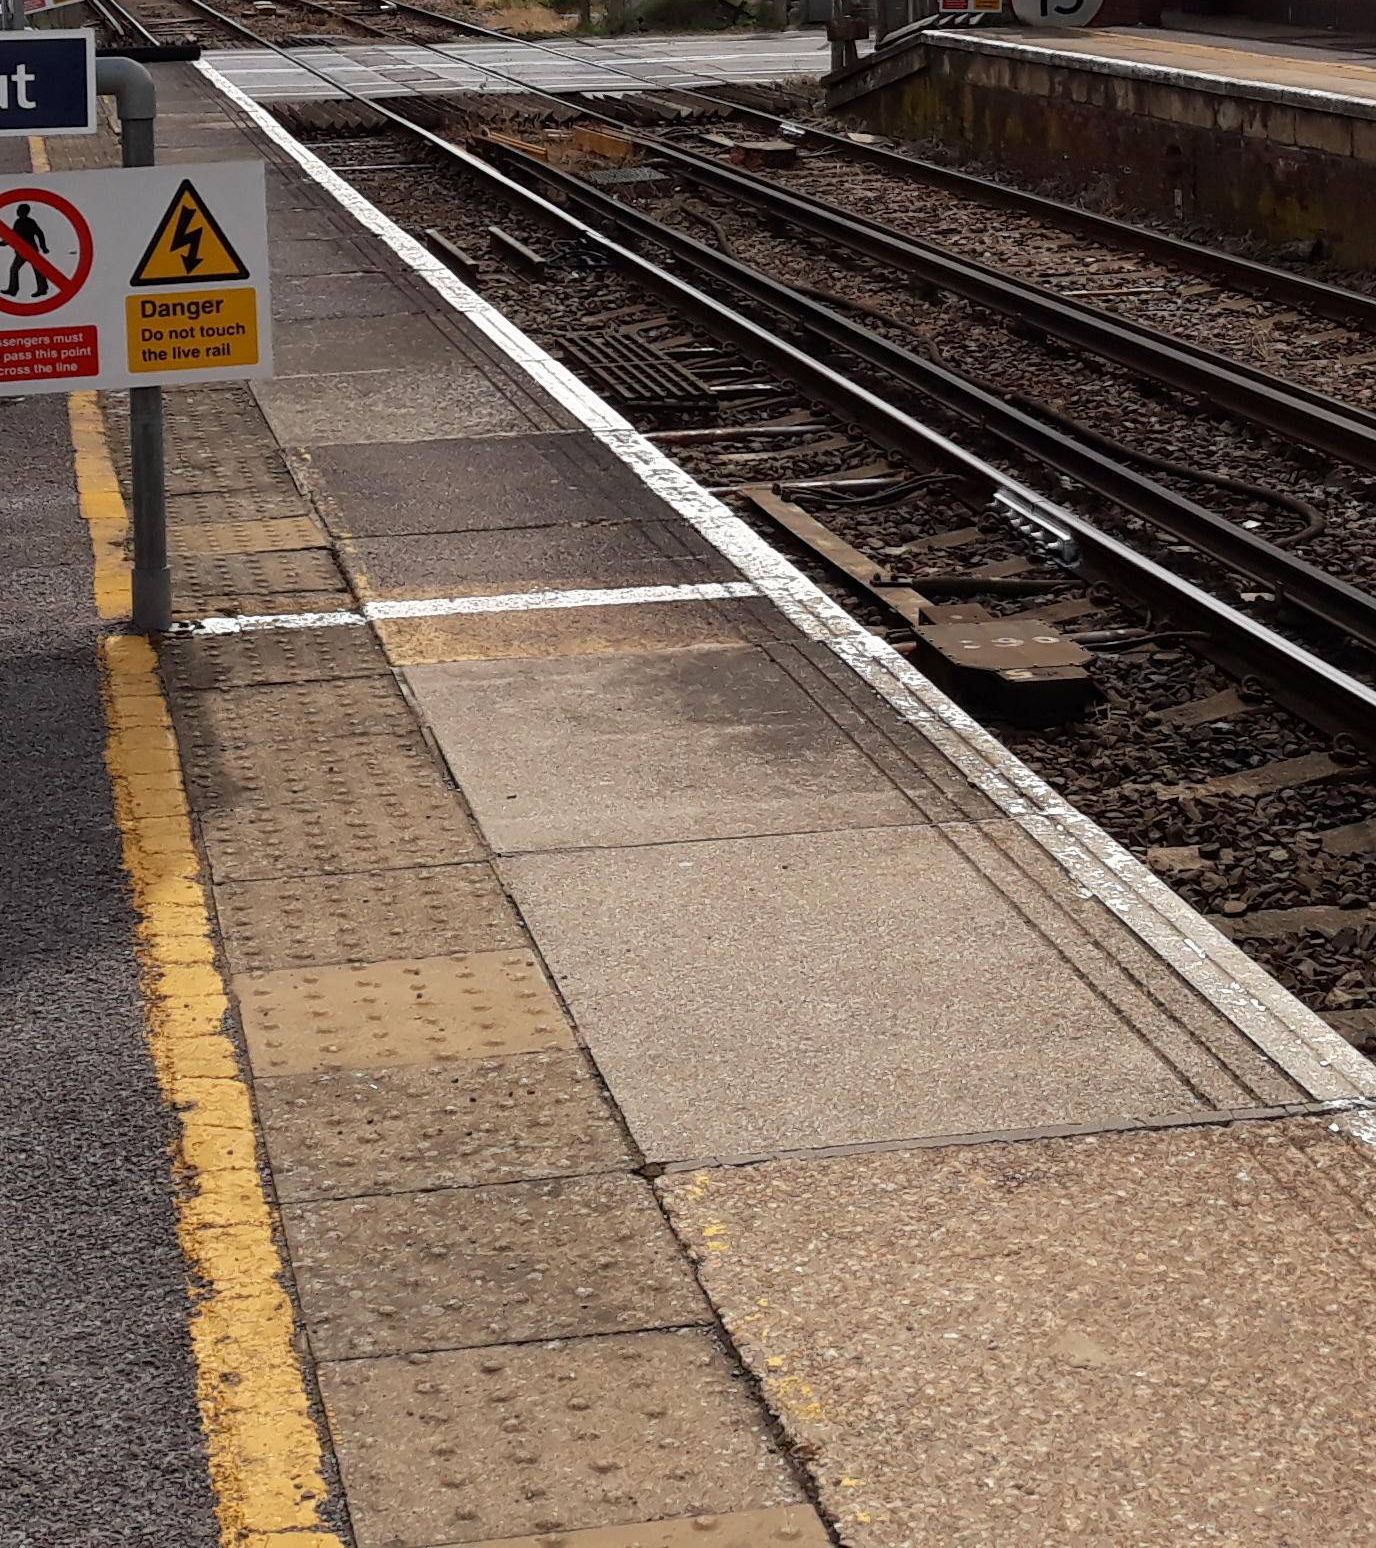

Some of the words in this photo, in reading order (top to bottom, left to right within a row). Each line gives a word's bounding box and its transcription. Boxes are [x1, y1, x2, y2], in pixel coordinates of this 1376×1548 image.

[140, 299, 224, 320] Danger
[53, 333, 84, 344] must
[141, 328, 164, 342] Do
[168, 326, 196, 340] not
[200, 322, 246, 338] touch
[4, 351, 32, 363] pass
[35, 348, 59, 359] this
[60, 346, 92, 359] point
[142, 347, 168, 362] the
[172, 345, 201, 360] live
[205, 342, 232, 357] rail
[33, 363, 53, 374] the
[55, 361, 79, 372] line
